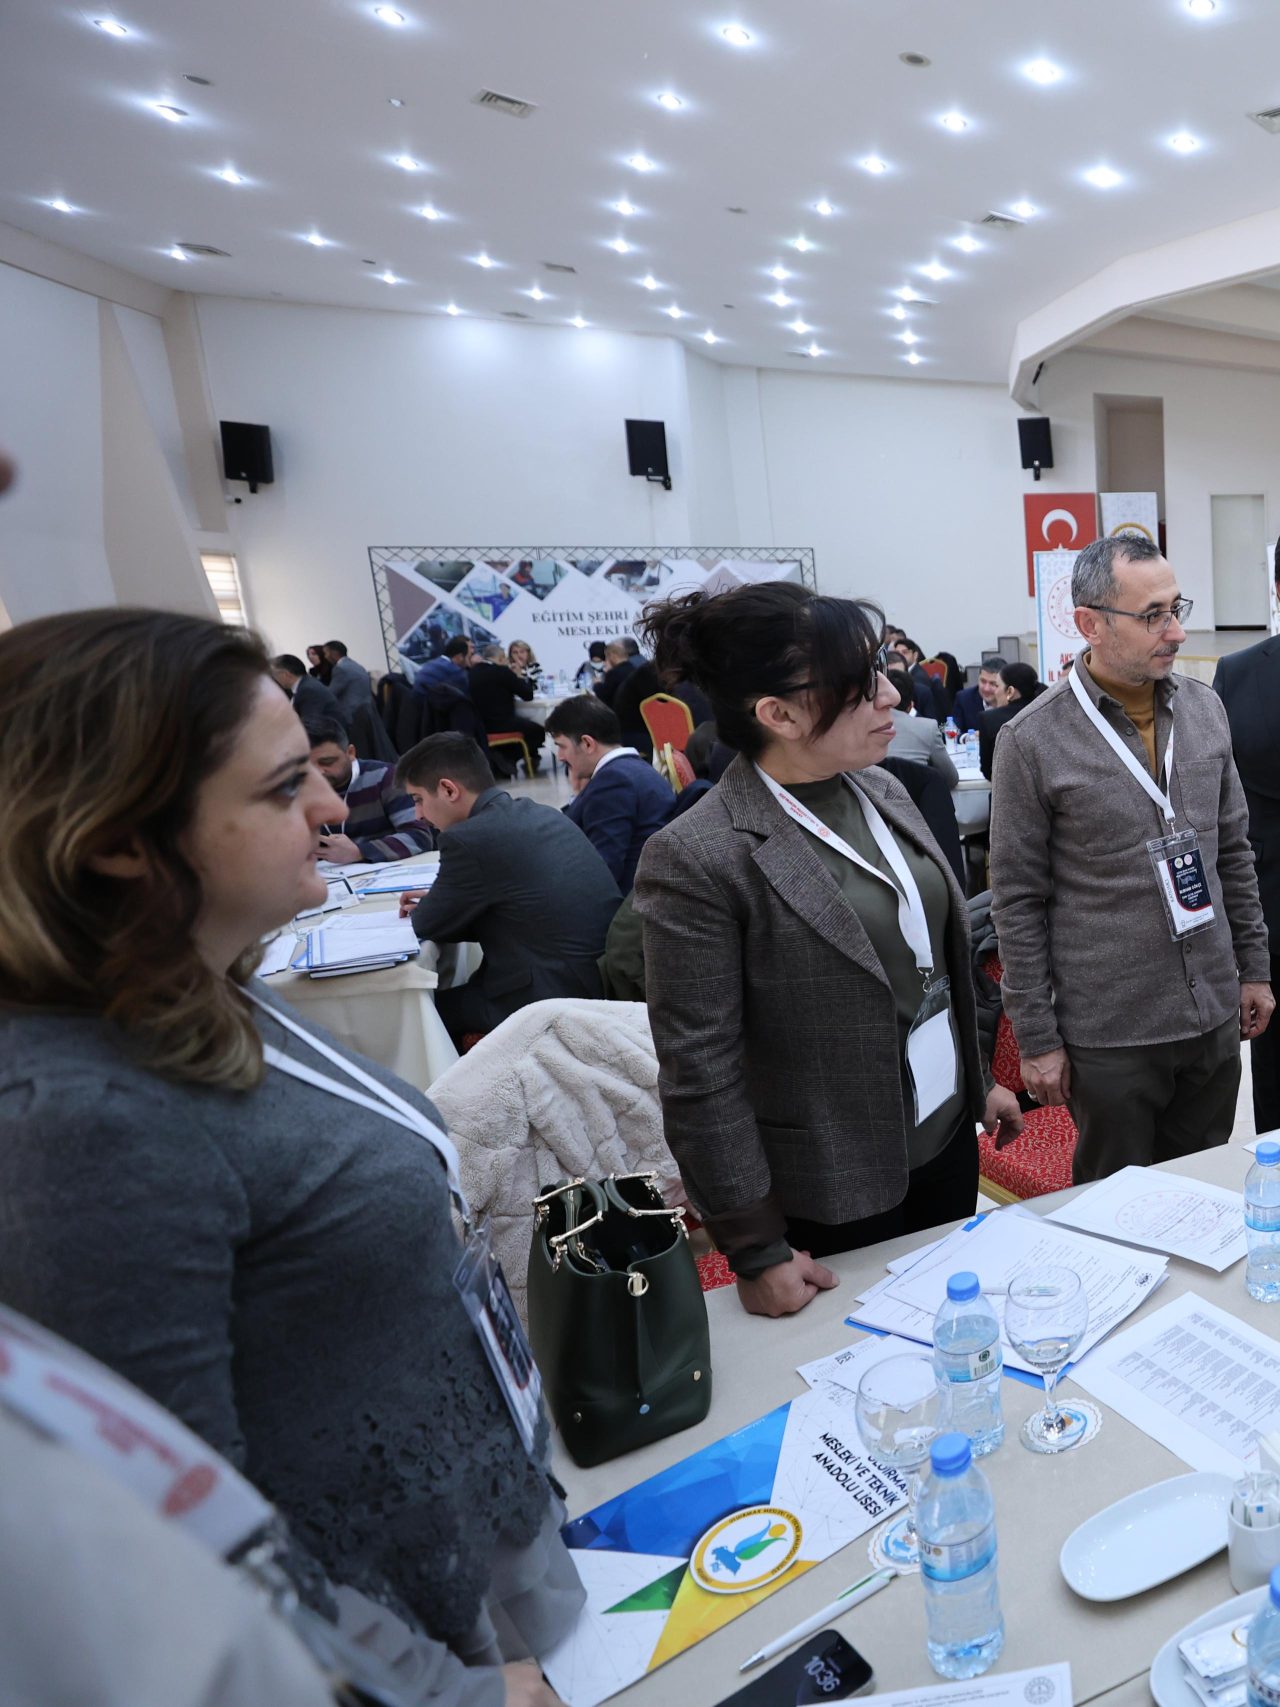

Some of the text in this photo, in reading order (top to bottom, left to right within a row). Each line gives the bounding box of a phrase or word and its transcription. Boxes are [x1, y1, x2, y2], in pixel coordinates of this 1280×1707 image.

[531, 610, 583, 623] EĞİTİM
[587, 608, 629, 623] ŞEHRİ
[557, 623, 620, 637] MESLEKİ
[812, 1452, 887, 1518] ANADOLU LİSESİ
[819, 1432, 900, 1507] MESLEKİ VE TEKNİK
[804, 1655, 840, 1692] 10:36
